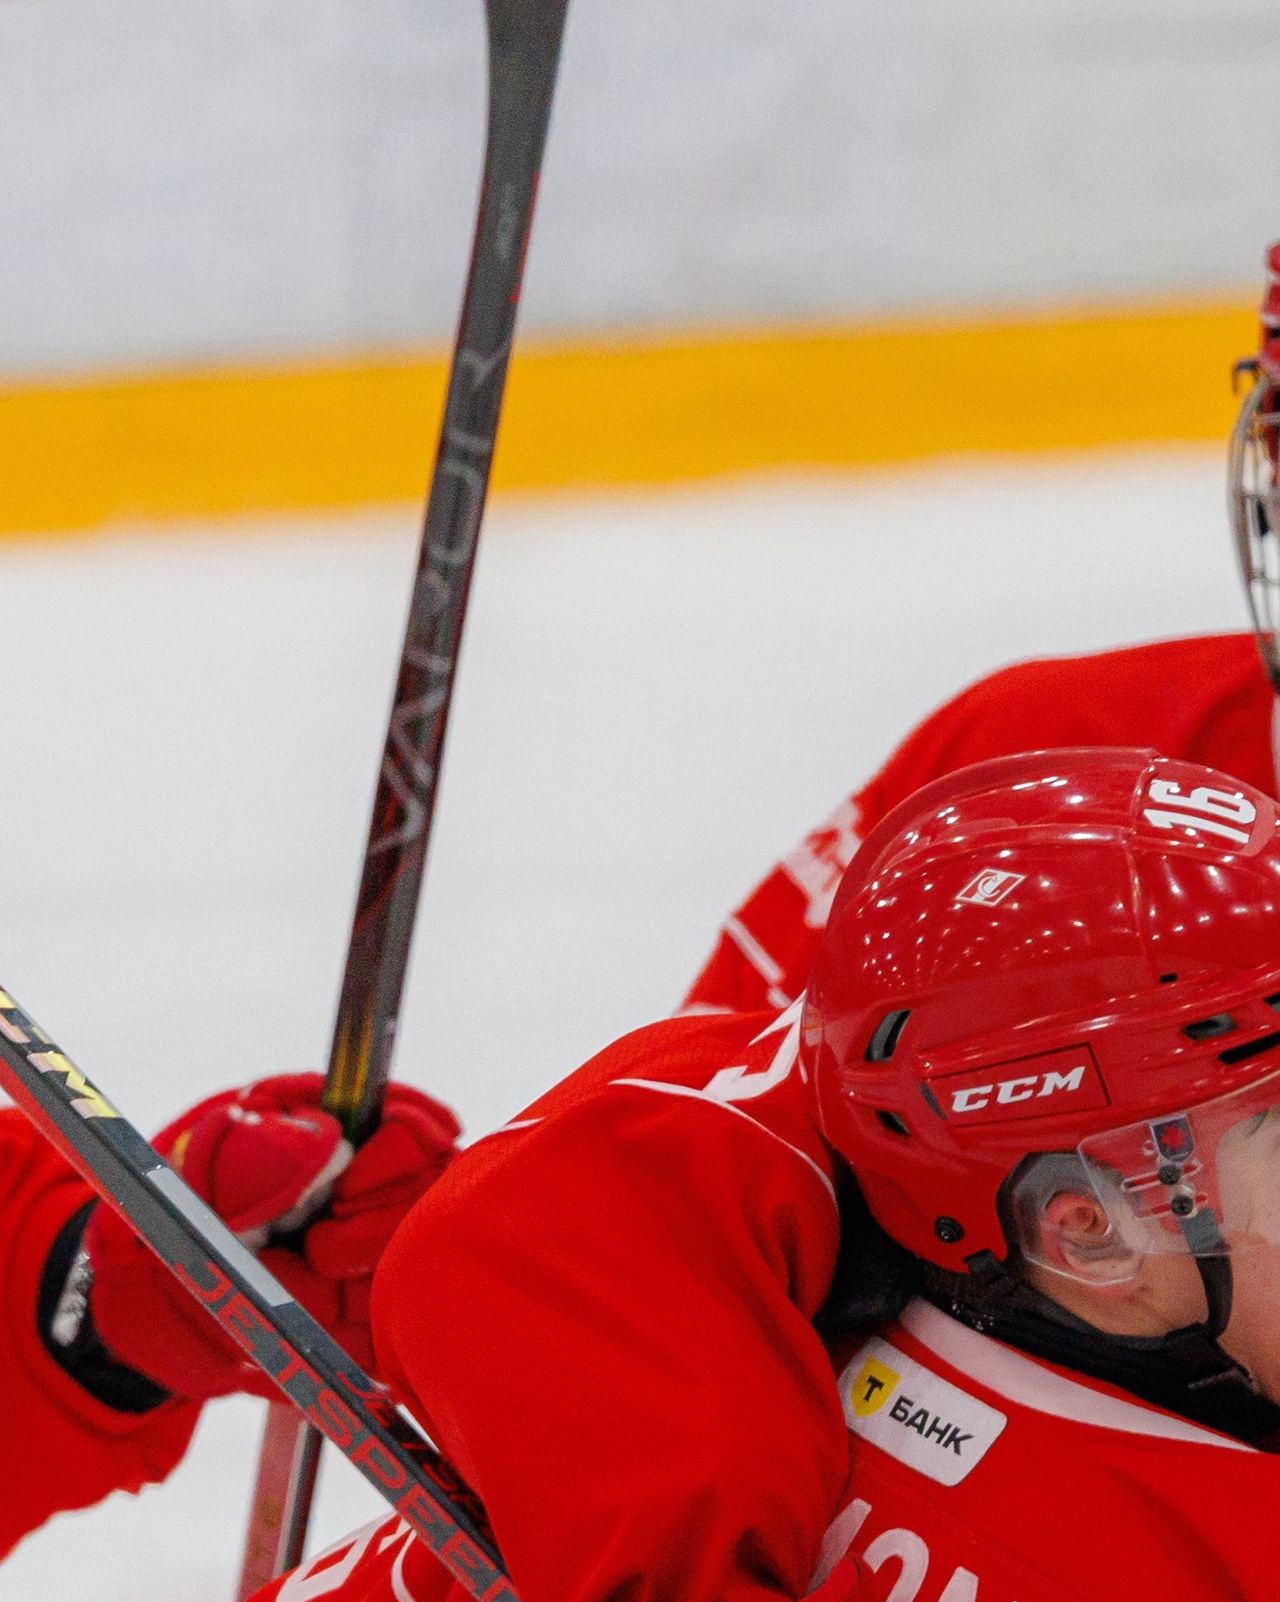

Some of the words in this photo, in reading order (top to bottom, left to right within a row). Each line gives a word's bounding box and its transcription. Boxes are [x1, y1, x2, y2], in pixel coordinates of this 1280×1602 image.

[1143, 778, 1257, 845] 16
[950, 1065, 1086, 1114] CCM
[888, 1395, 975, 1456] БАНК
